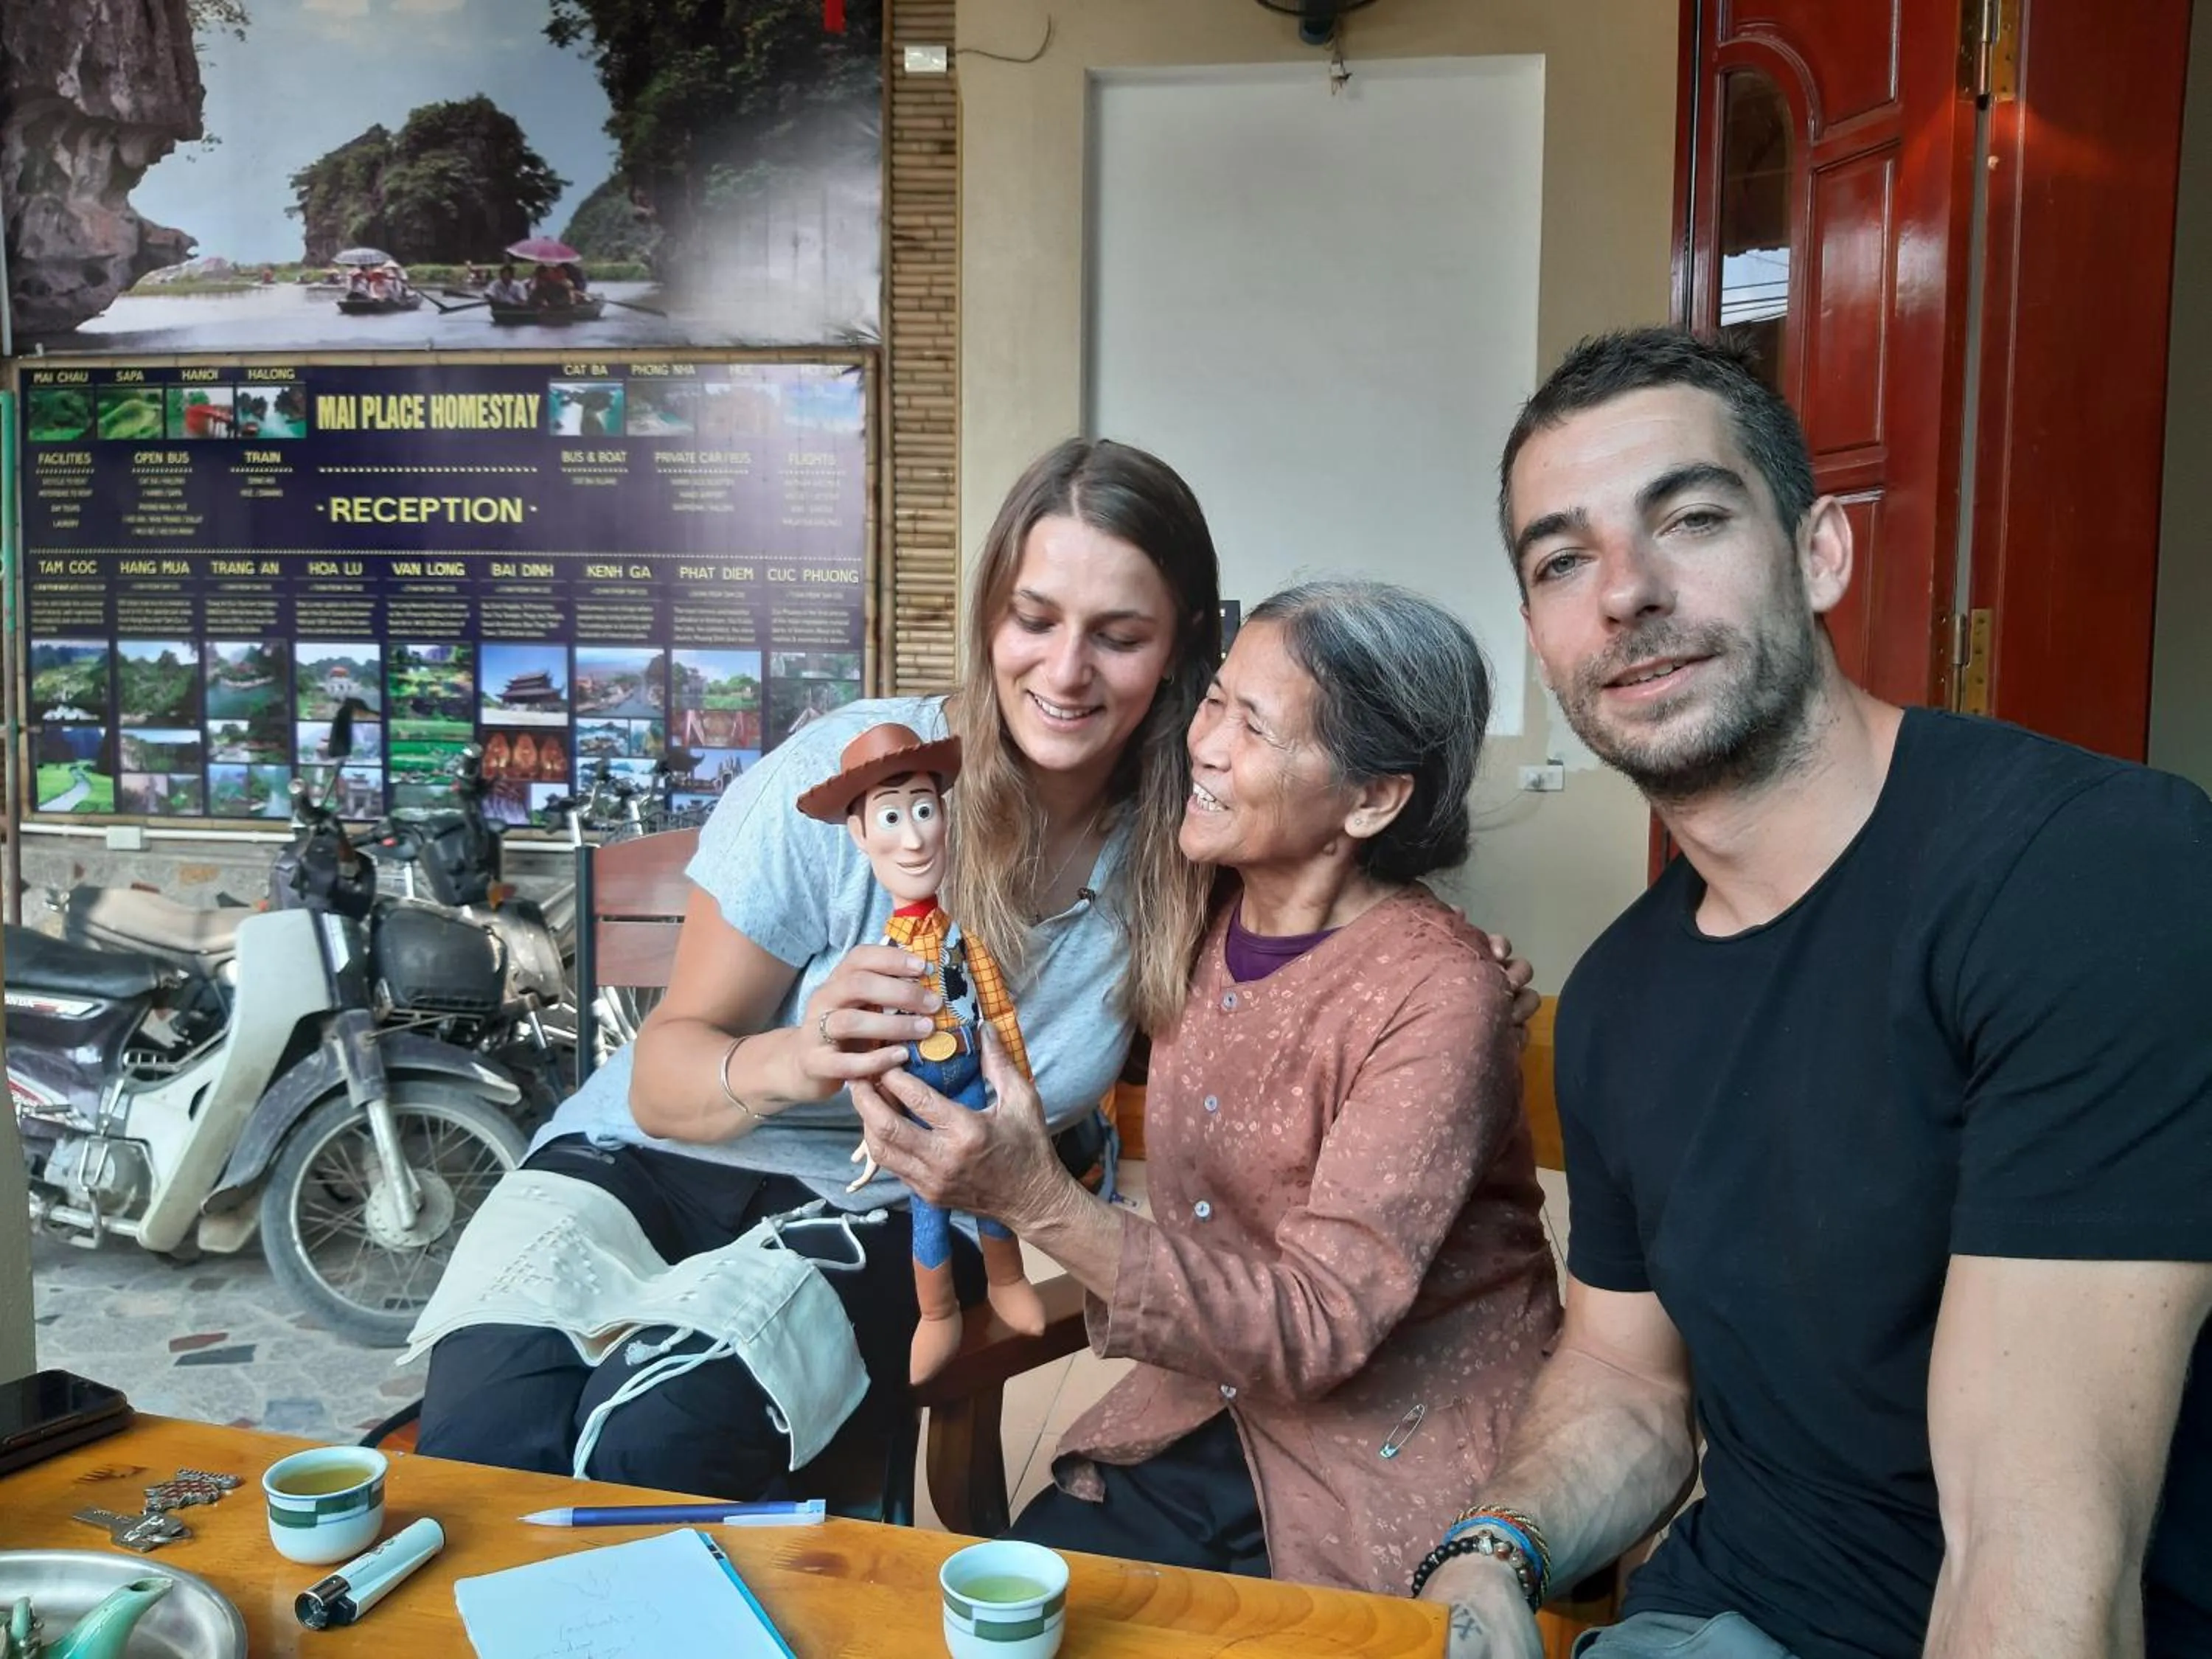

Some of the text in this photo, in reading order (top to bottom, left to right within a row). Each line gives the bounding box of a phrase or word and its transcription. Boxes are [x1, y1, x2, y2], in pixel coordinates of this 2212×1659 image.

[116, 371, 145, 382] SAPA
[181, 369, 219, 380] HANOI
[248, 369, 295, 380] HALONG
[563, 364, 609, 376] CAT BA
[631, 364, 669, 376] PHONG
[316, 394, 540, 430] MAI PLACE HOMESTAY
[38, 452, 92, 465] FACILITIES
[134, 451, 189, 464] OPEN BUS
[245, 451, 281, 464] TRAIN
[561, 451, 584, 463] BUS
[598, 451, 627, 463] BOAT
[330, 496, 524, 523] RECEPTION
[38, 560, 98, 574] TAM COC
[119, 561, 190, 574] HANG MUA
[211, 561, 279, 574] TRANG AN
[308, 563, 363, 577] HOA LU
[392, 563, 465, 577] VAN LONG
[491, 563, 554, 577] BAI DINH
[585, 566, 652, 579] KENH GA
[680, 566, 754, 580] PHAT DIEM
[768, 568, 860, 583] CUC PHUONG
